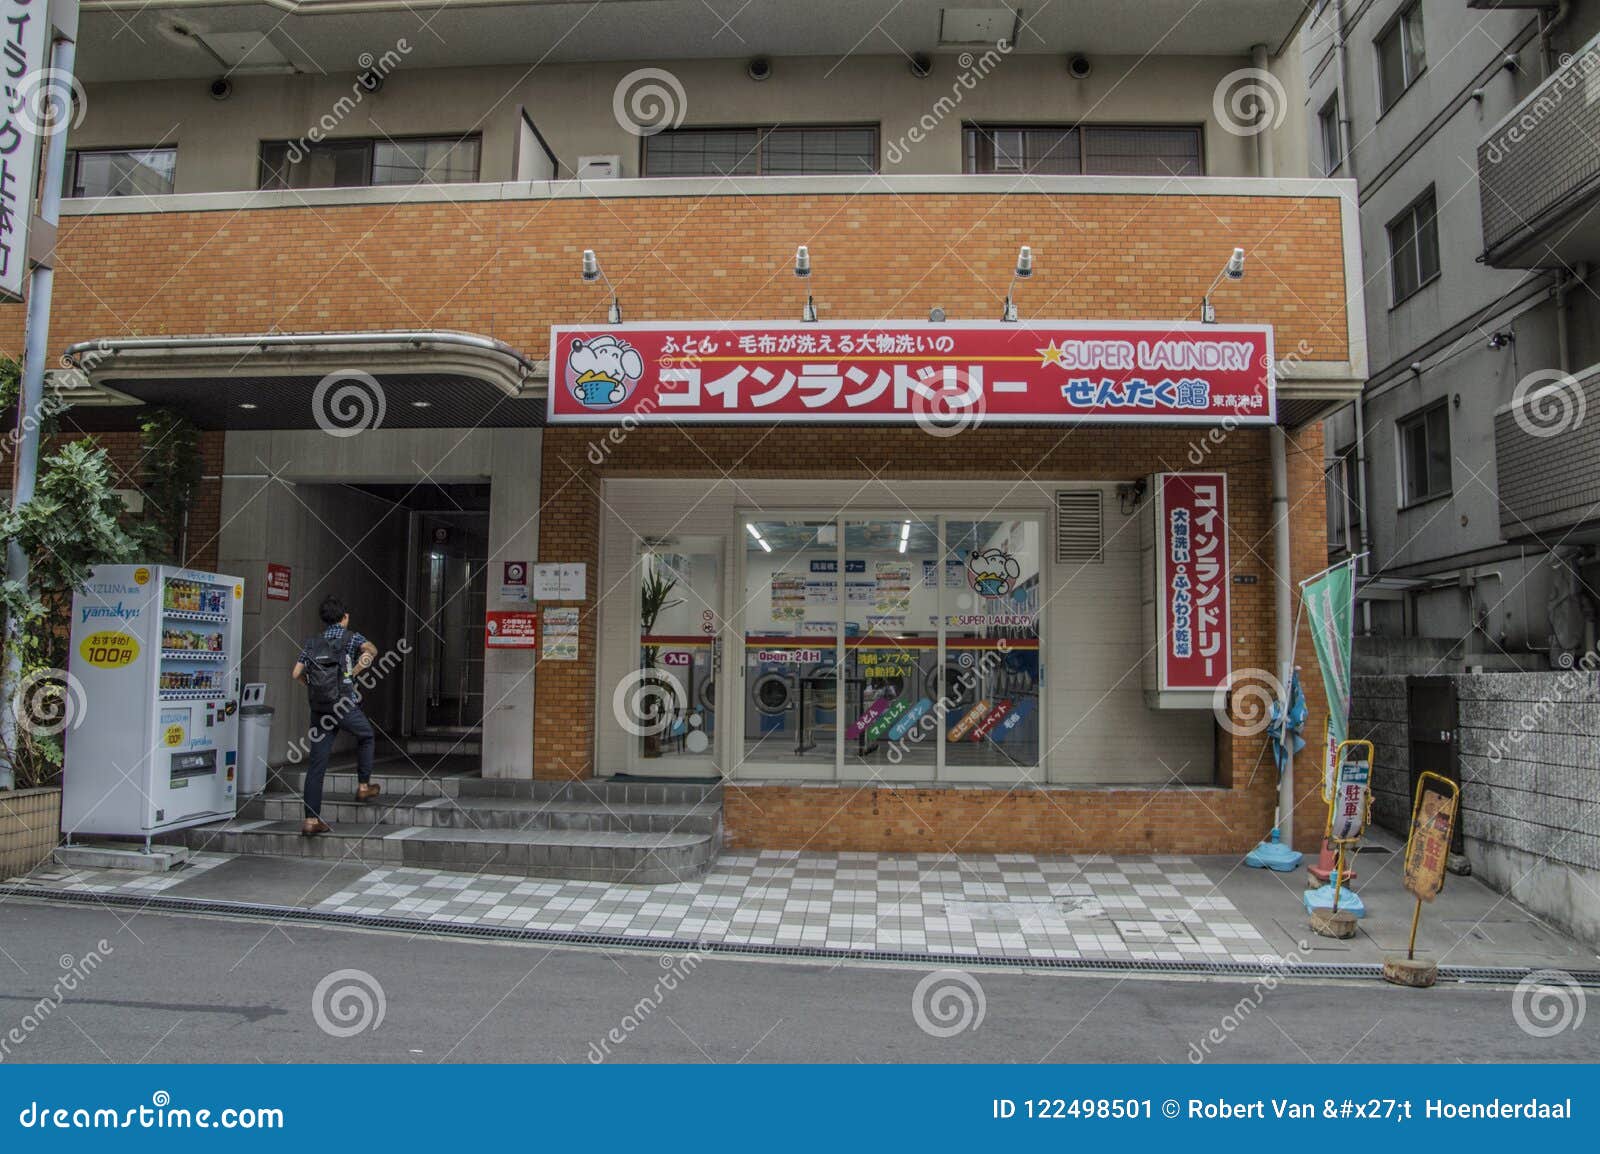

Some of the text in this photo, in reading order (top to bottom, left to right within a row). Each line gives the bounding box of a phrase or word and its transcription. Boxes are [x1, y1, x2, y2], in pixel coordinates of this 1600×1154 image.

[660, 335, 954, 354] ふとん・毛布が洗える大物洗いの
[1062, 341, 1254, 370] SUPER LAUNDRY
[658, 365, 1027, 408] コインランドリー
[1061, 379, 1209, 408] せんたく館
[1194, 485, 1220, 677] コインランドリー
[958, 615, 985, 626] SUPER
[88, 648, 132, 663] 100円
[668, 654, 689, 664] 入口
[870, 701, 906, 735] マットレス
[974, 705, 1006, 738] カーペット
[1343, 785, 1360, 817] 駐車
